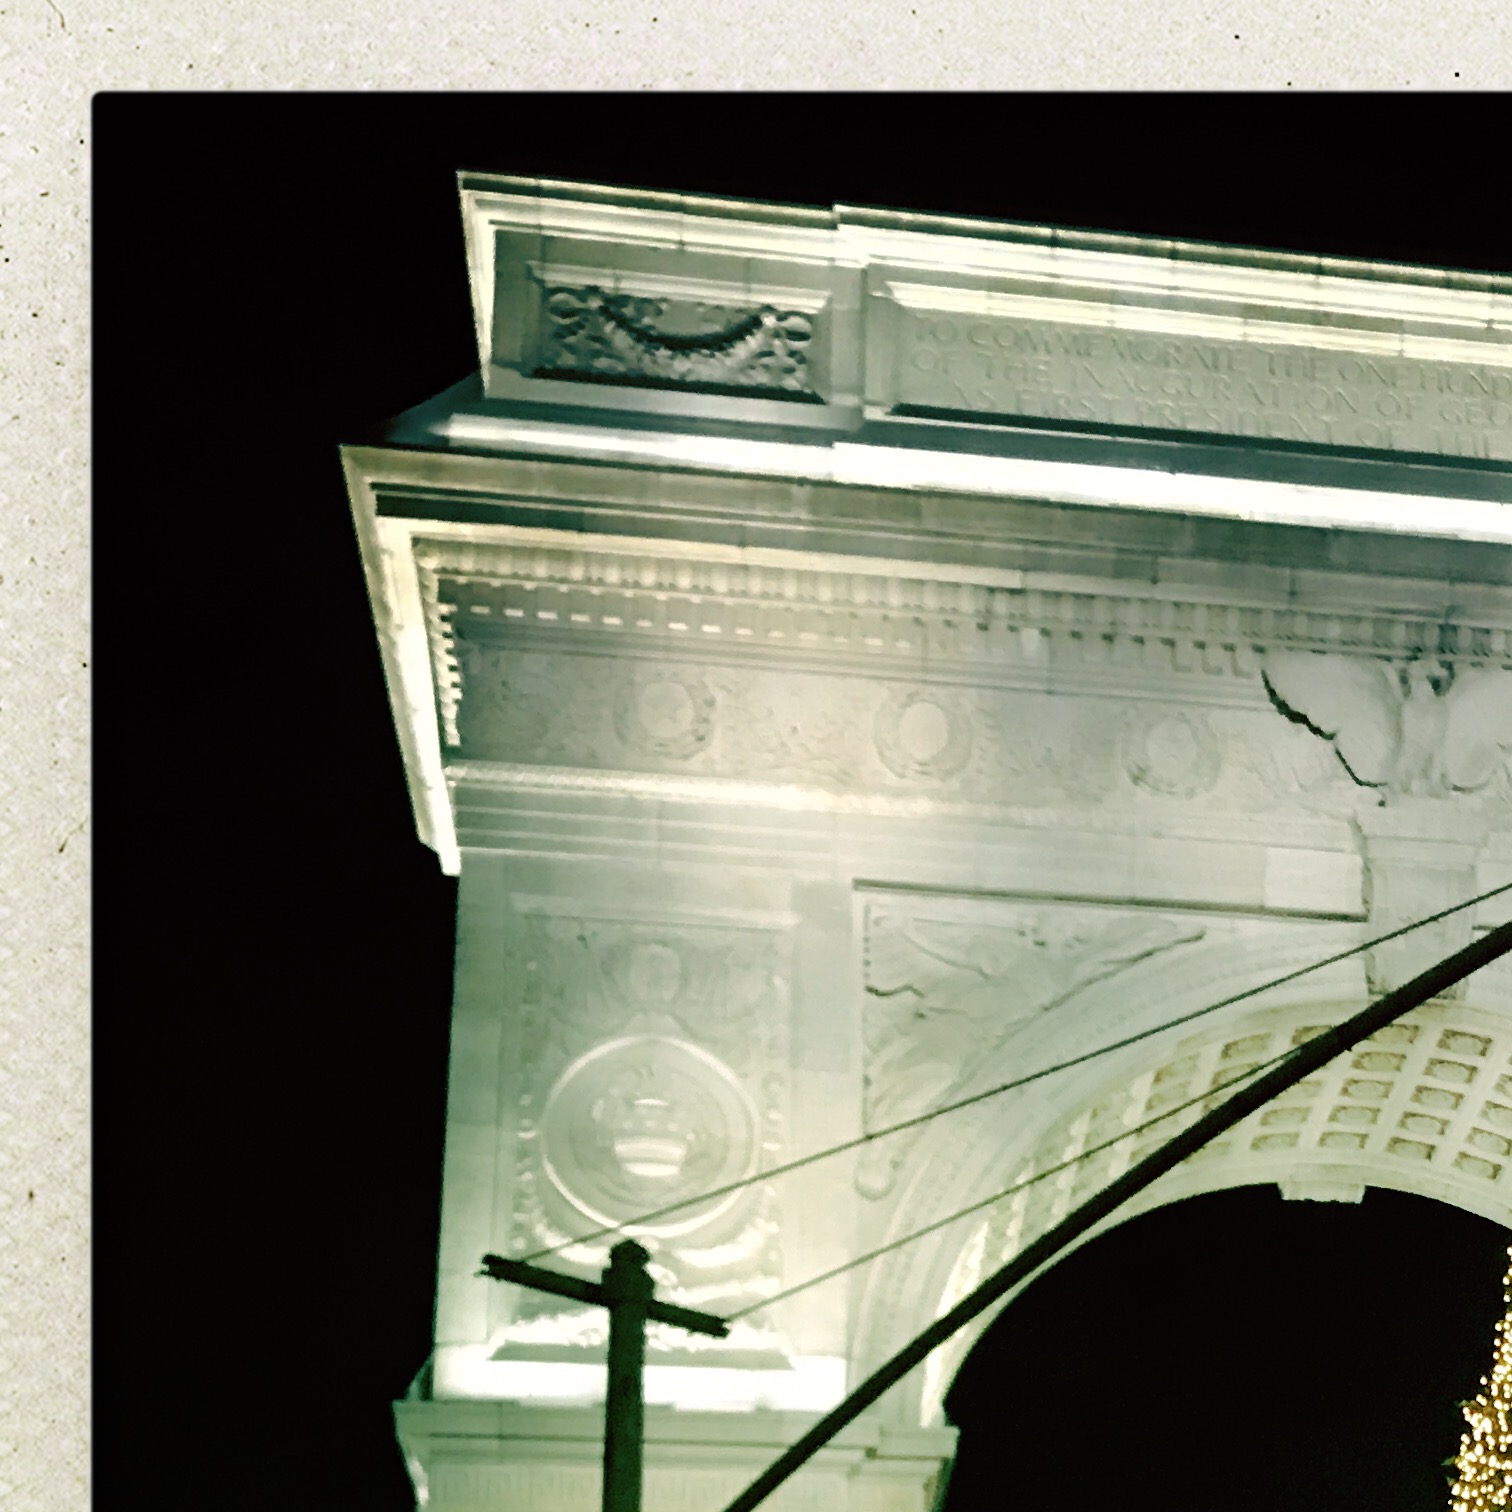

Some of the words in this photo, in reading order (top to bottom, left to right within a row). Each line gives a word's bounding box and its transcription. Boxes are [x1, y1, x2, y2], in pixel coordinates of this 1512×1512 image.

[911, 346, 963, 375] OF
[976, 351, 1051, 385] THE
[1070, 359, 1359, 414] INAUGURATION
[1375, 391, 1423, 421] OF
[966, 322, 1246, 371] COMMEMORATE
[1255, 345, 1328, 381] THE
[1337, 358, 1405, 388] ONE
[1014, 387, 1121, 425] FIRST
[1137, 398, 1338, 444] PRESIDENT
